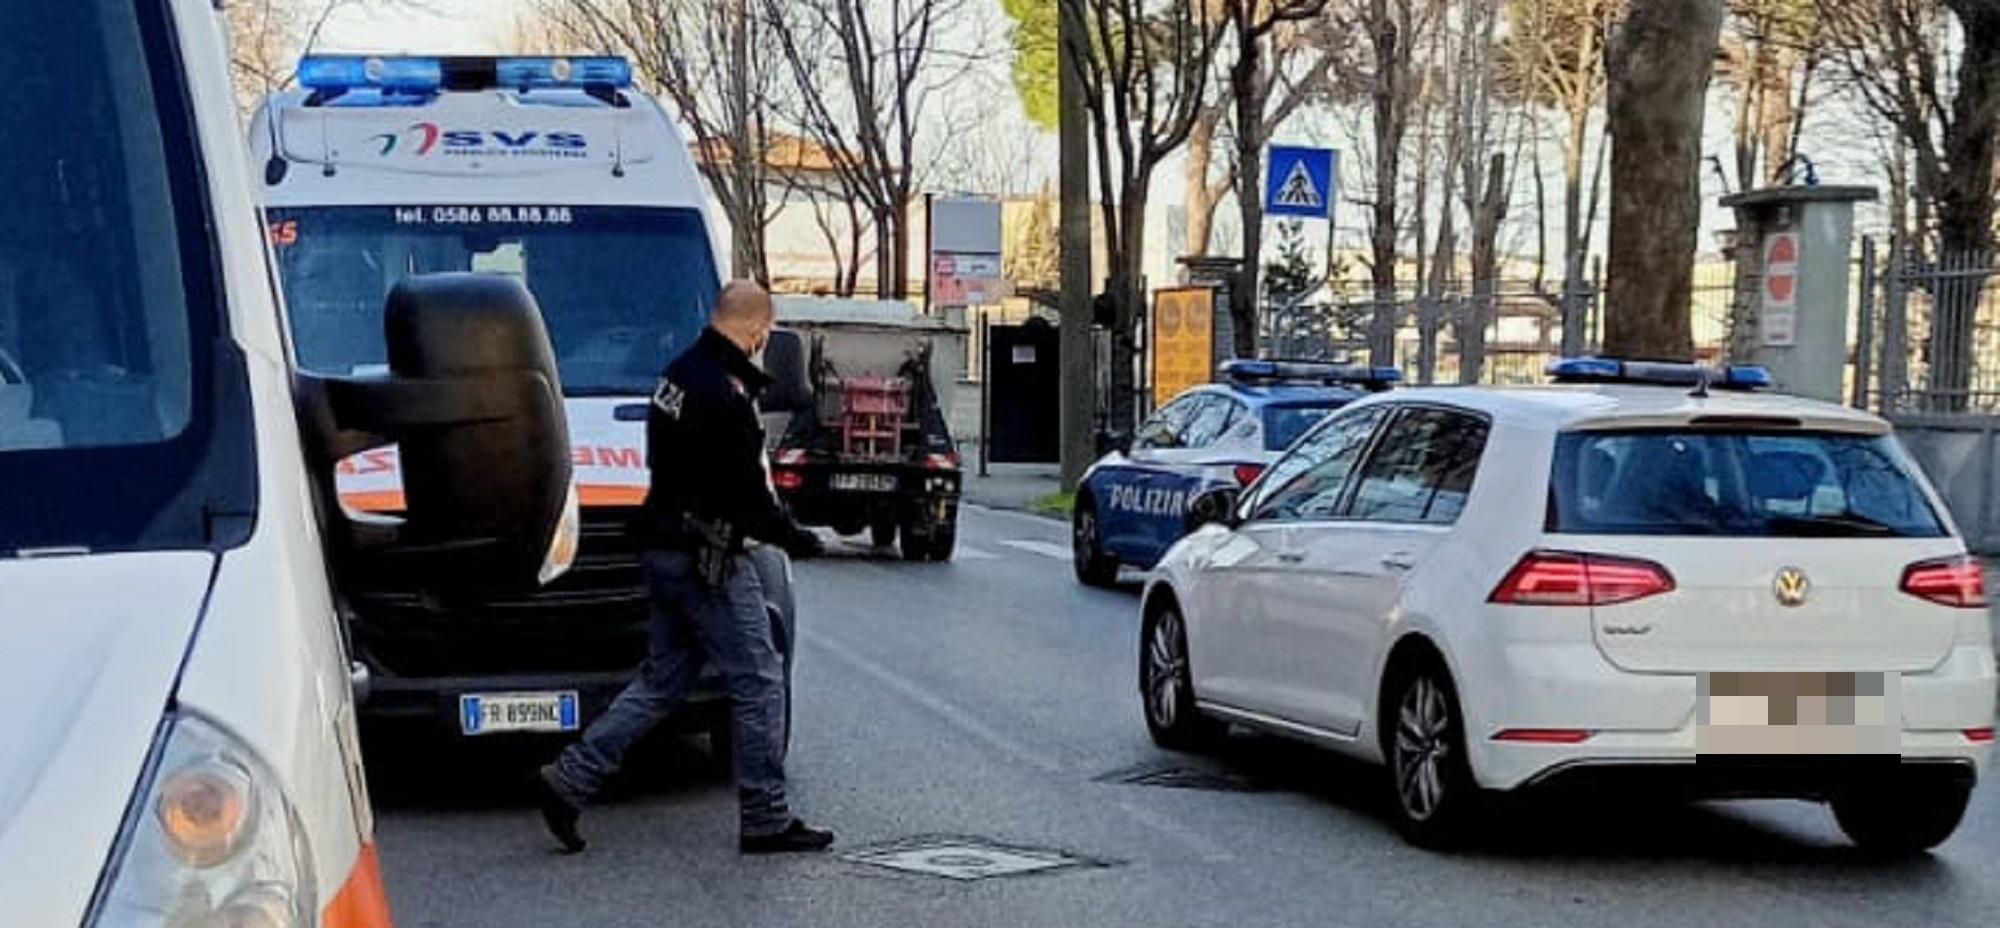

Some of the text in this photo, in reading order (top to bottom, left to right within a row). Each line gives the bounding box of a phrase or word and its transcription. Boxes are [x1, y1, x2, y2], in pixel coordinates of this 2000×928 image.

[442, 131, 588, 148] SVS
[395, 207, 573, 223] tel. 0586 88.88.88
[1109, 483, 1184, 517] POLIZIA
